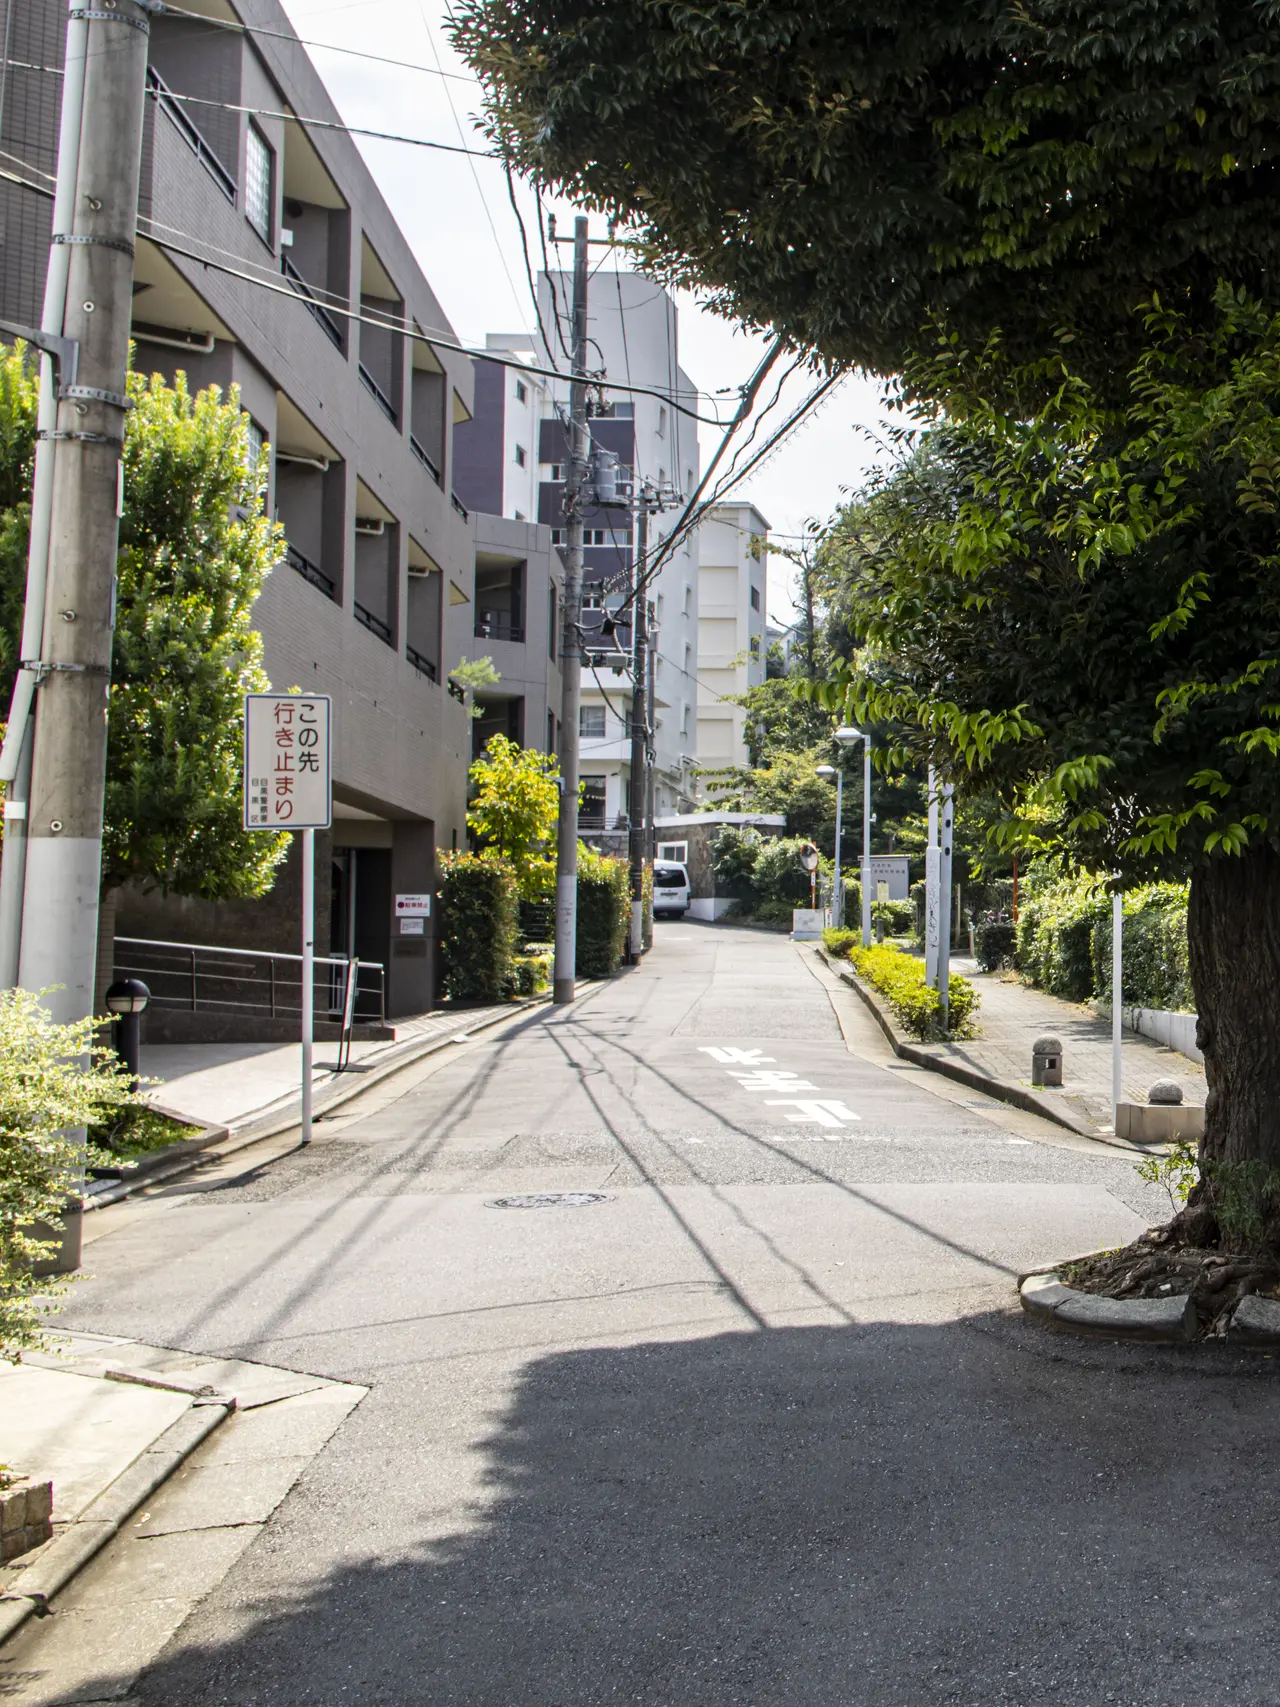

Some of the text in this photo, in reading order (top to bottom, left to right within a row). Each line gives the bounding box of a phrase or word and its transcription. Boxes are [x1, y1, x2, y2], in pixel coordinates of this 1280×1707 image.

[274, 702, 295, 820] 行き止まり
[298, 703, 319, 773] この先
